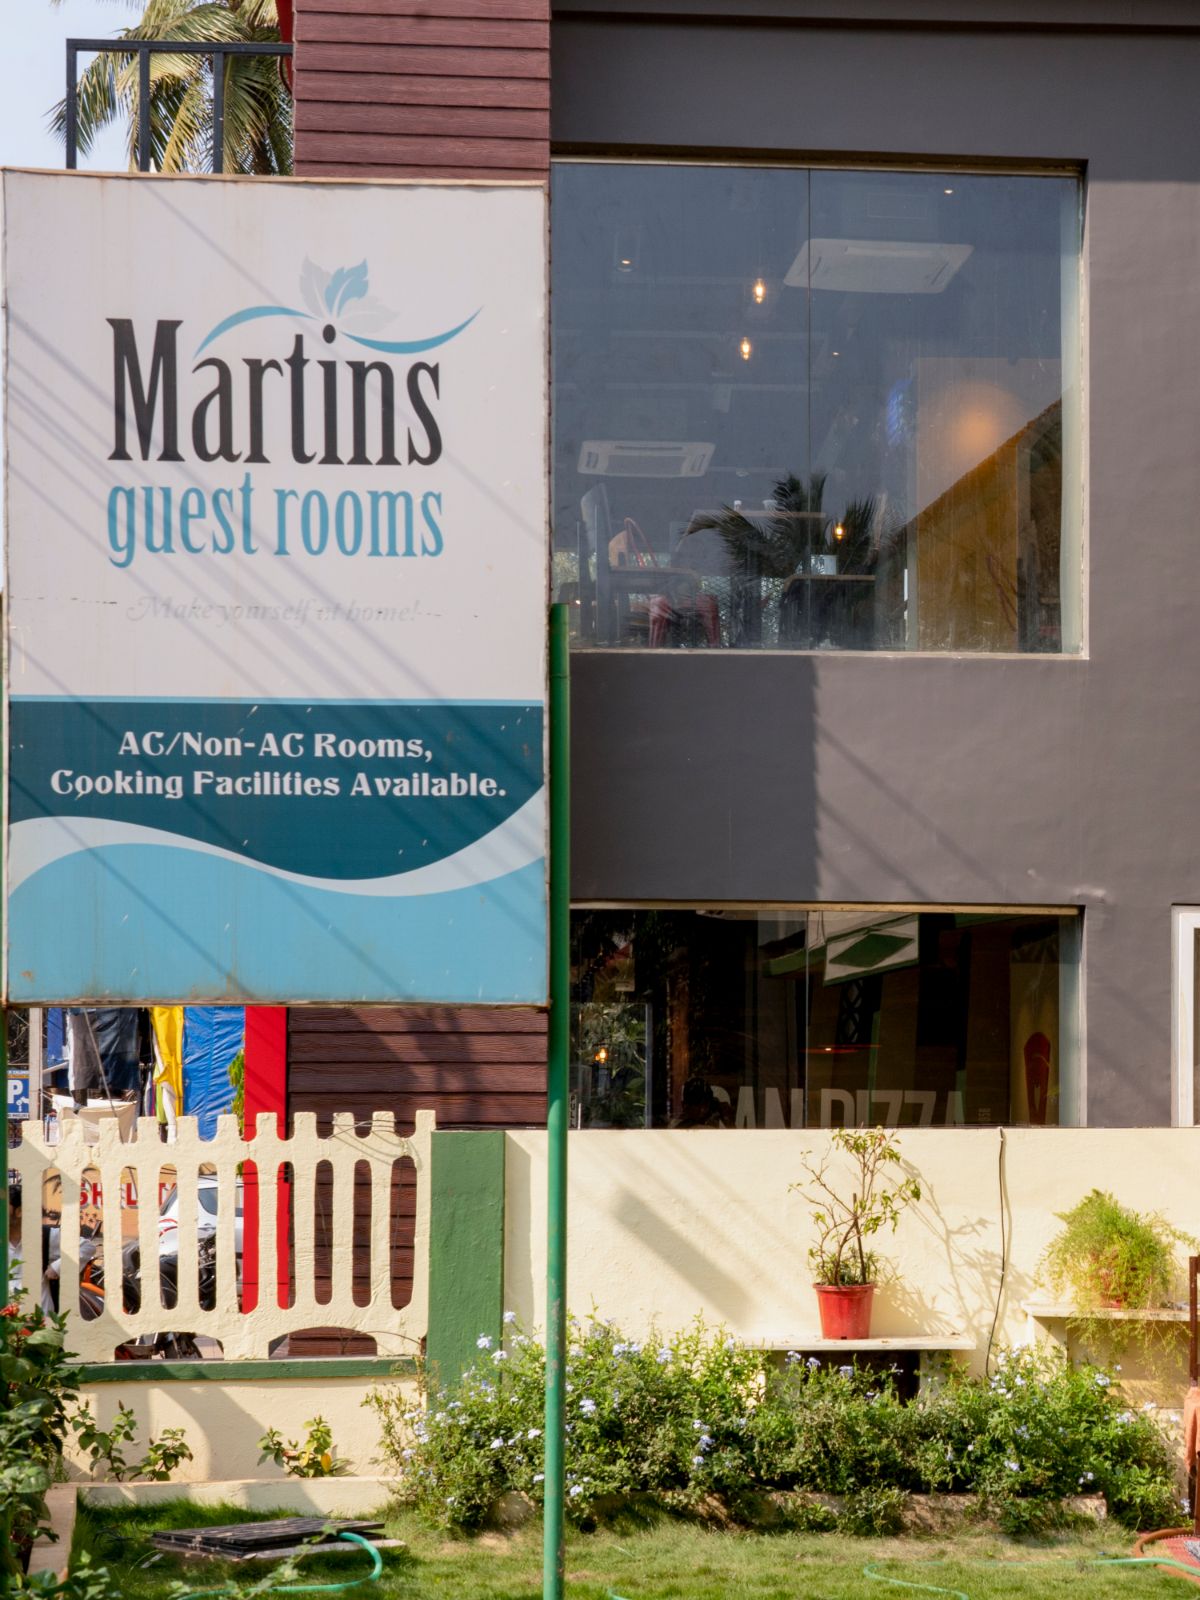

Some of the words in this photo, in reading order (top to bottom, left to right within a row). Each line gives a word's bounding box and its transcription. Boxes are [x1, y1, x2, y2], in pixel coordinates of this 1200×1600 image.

[105, 318, 443, 466] Martins
[106, 472, 259, 569] guest
[273, 487, 445, 558] rooms
[117, 731, 305, 757] AC/Non-AC
[314, 733, 433, 763] Rooms,
[50, 769, 184, 799] Cooking
[193, 771, 341, 796] Facilities
[350, 773, 507, 797] Available.
